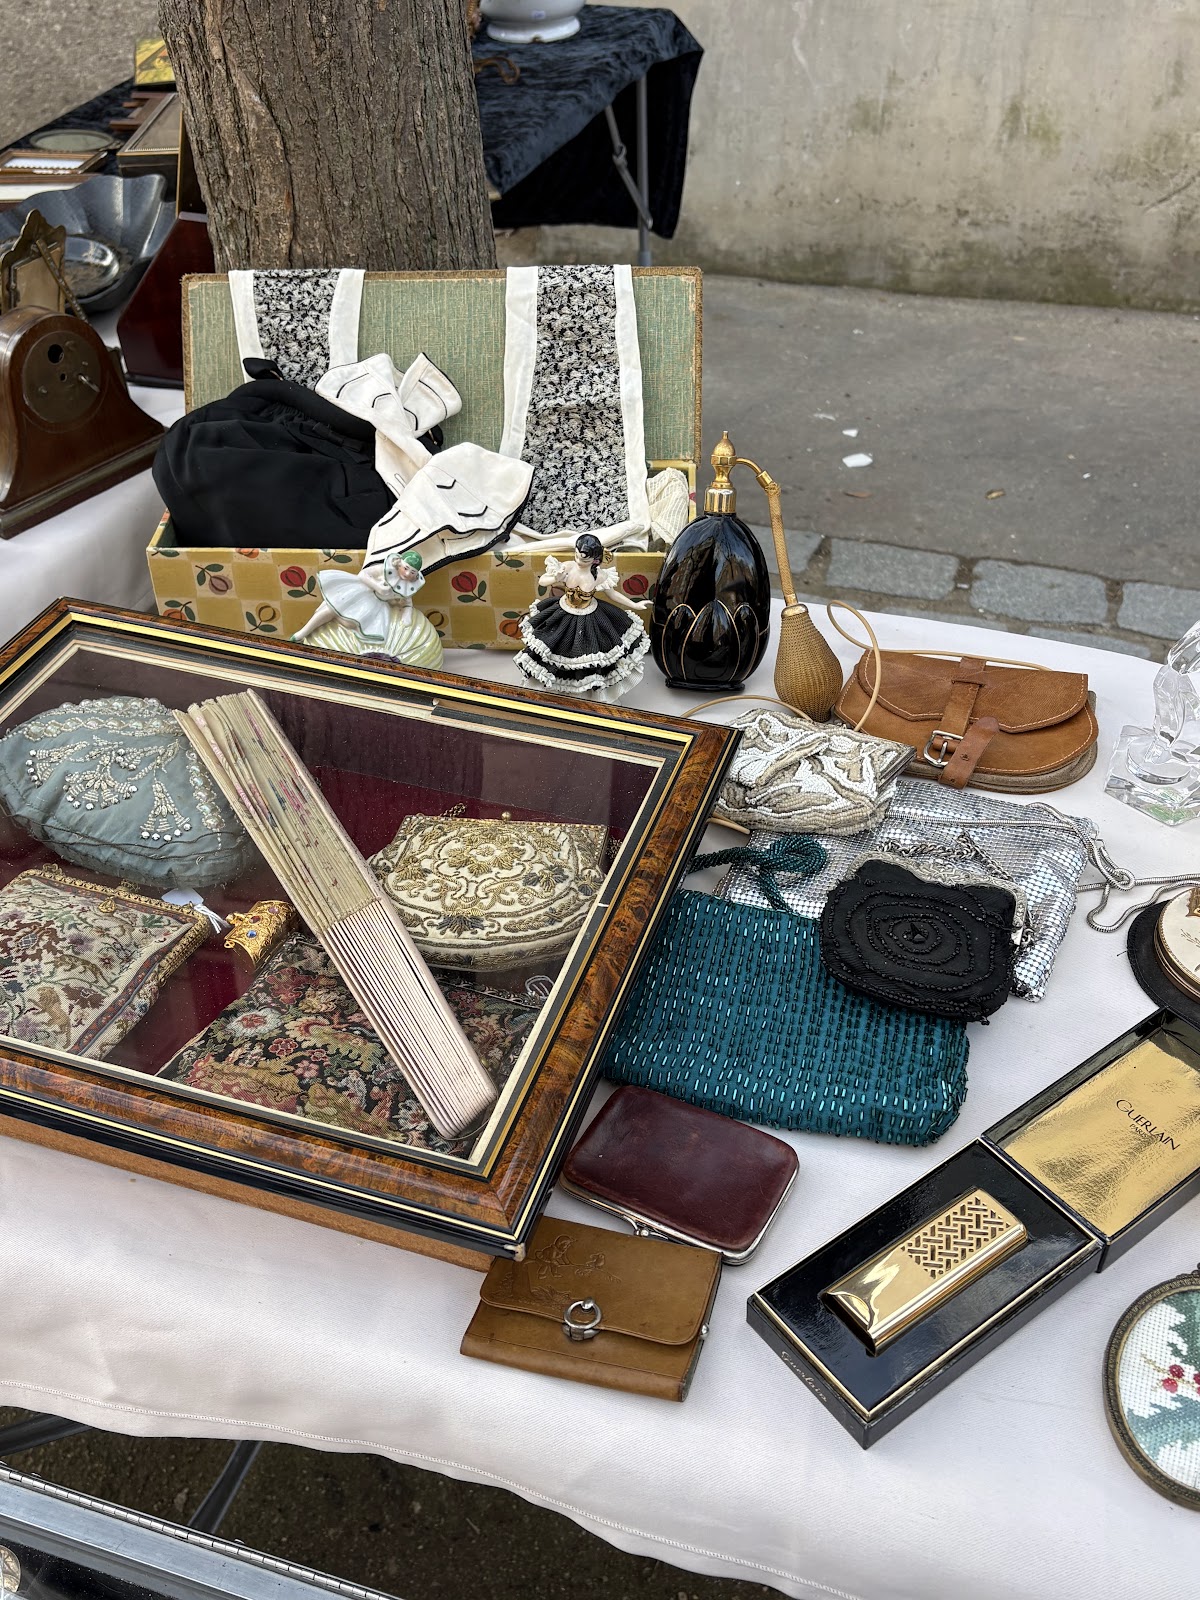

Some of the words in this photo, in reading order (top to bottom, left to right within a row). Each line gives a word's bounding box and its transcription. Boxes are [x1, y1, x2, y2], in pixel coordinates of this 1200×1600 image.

[1116, 1099, 1181, 1151] GUERLAIN
[1129, 1123, 1148, 1140] PARIS
[781, 1351, 827, 1402] Guerlain
